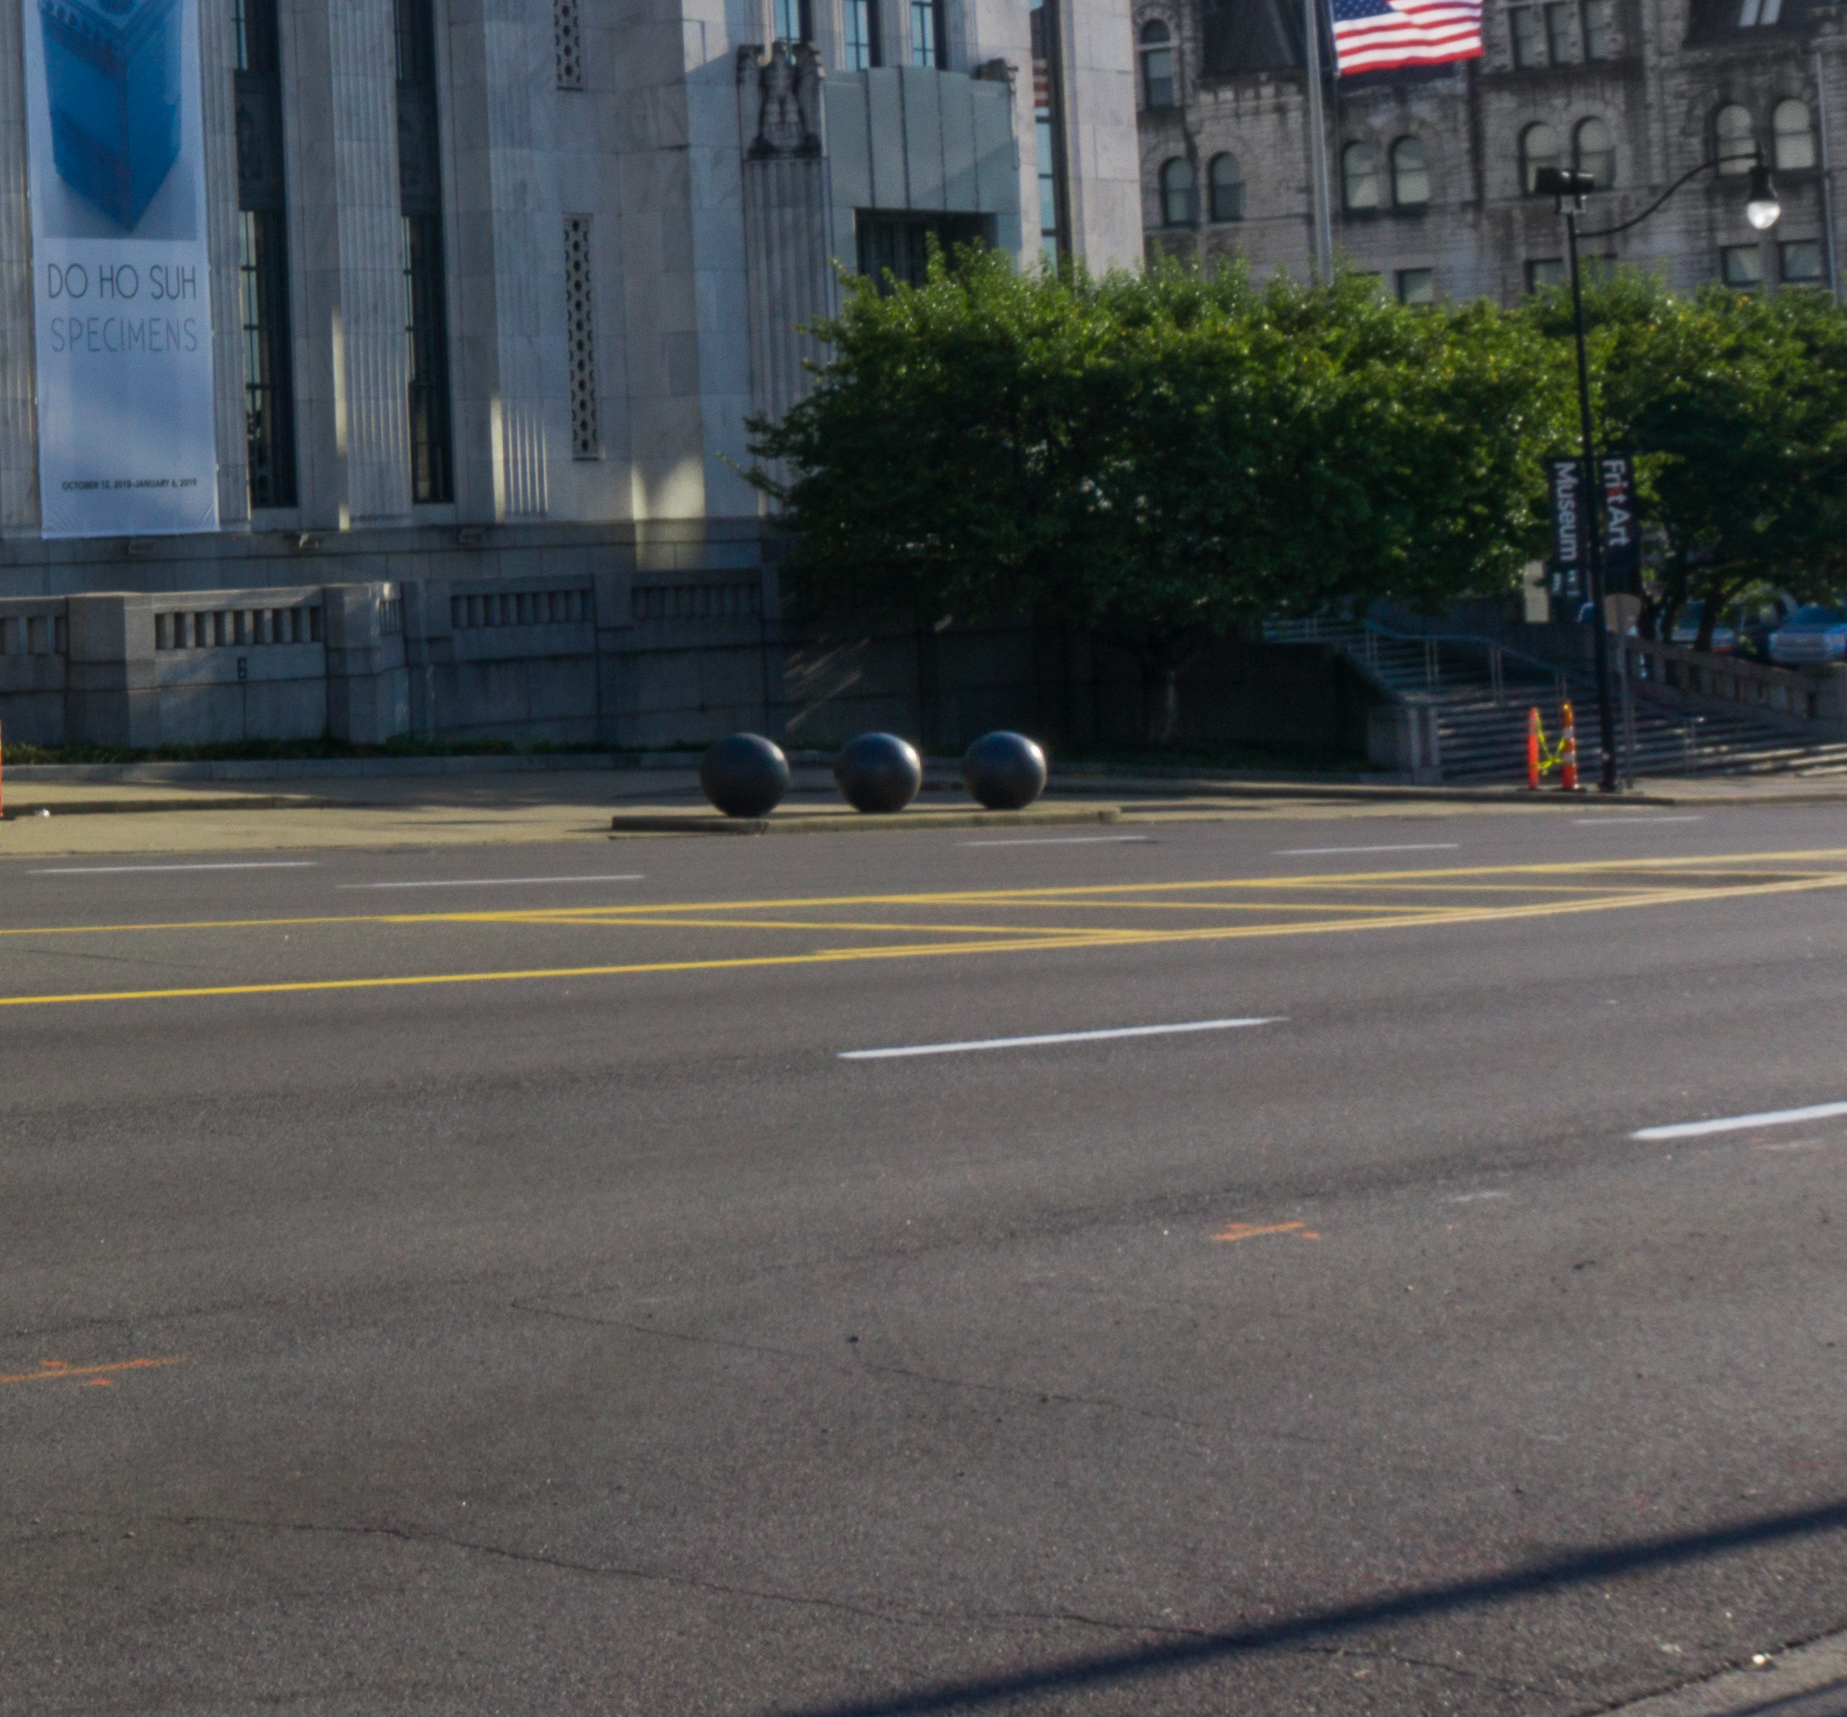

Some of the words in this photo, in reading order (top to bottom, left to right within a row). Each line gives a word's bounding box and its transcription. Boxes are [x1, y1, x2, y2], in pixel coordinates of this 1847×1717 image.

[47, 263, 89, 300] DO
[99, 264, 140, 299] HO
[149, 265, 197, 300] SUH
[50, 317, 198, 354] SPECIMENS
[1554, 461, 1579, 561] Museum
[1608, 505, 1632, 546] Art
